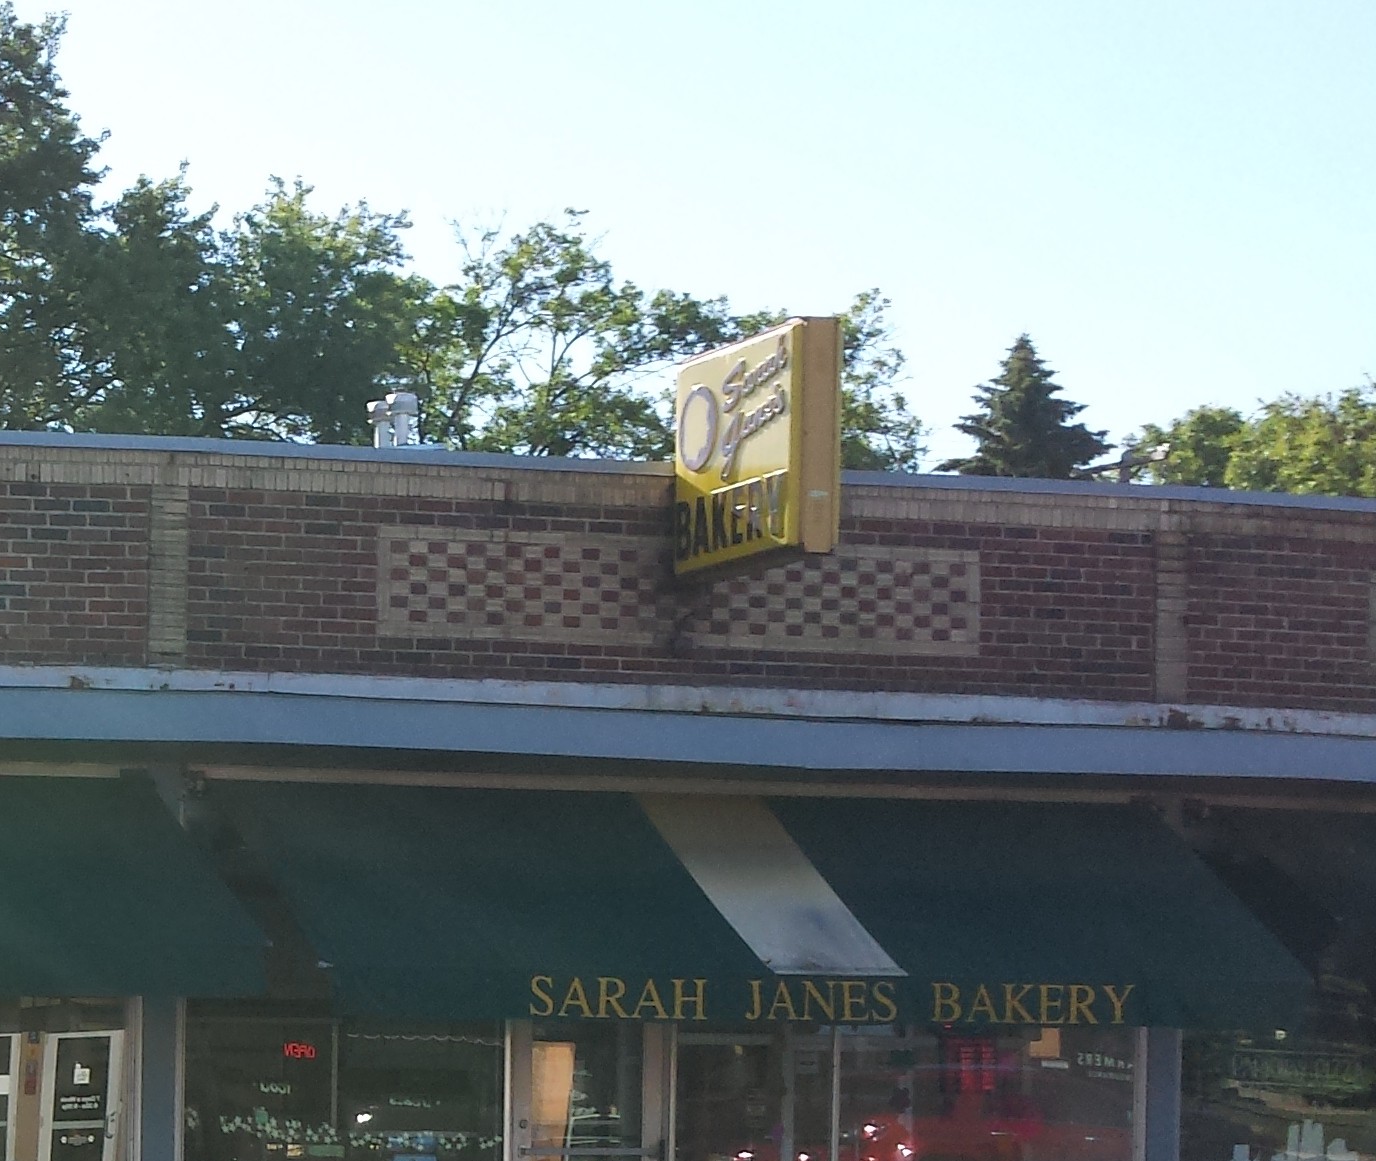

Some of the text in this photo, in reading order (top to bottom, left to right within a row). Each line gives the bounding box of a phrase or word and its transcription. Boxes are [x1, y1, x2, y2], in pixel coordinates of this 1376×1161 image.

[676, 472, 786, 562] BAKERY
[529, 974, 1135, 1025] SARAH JANES BAKERY
